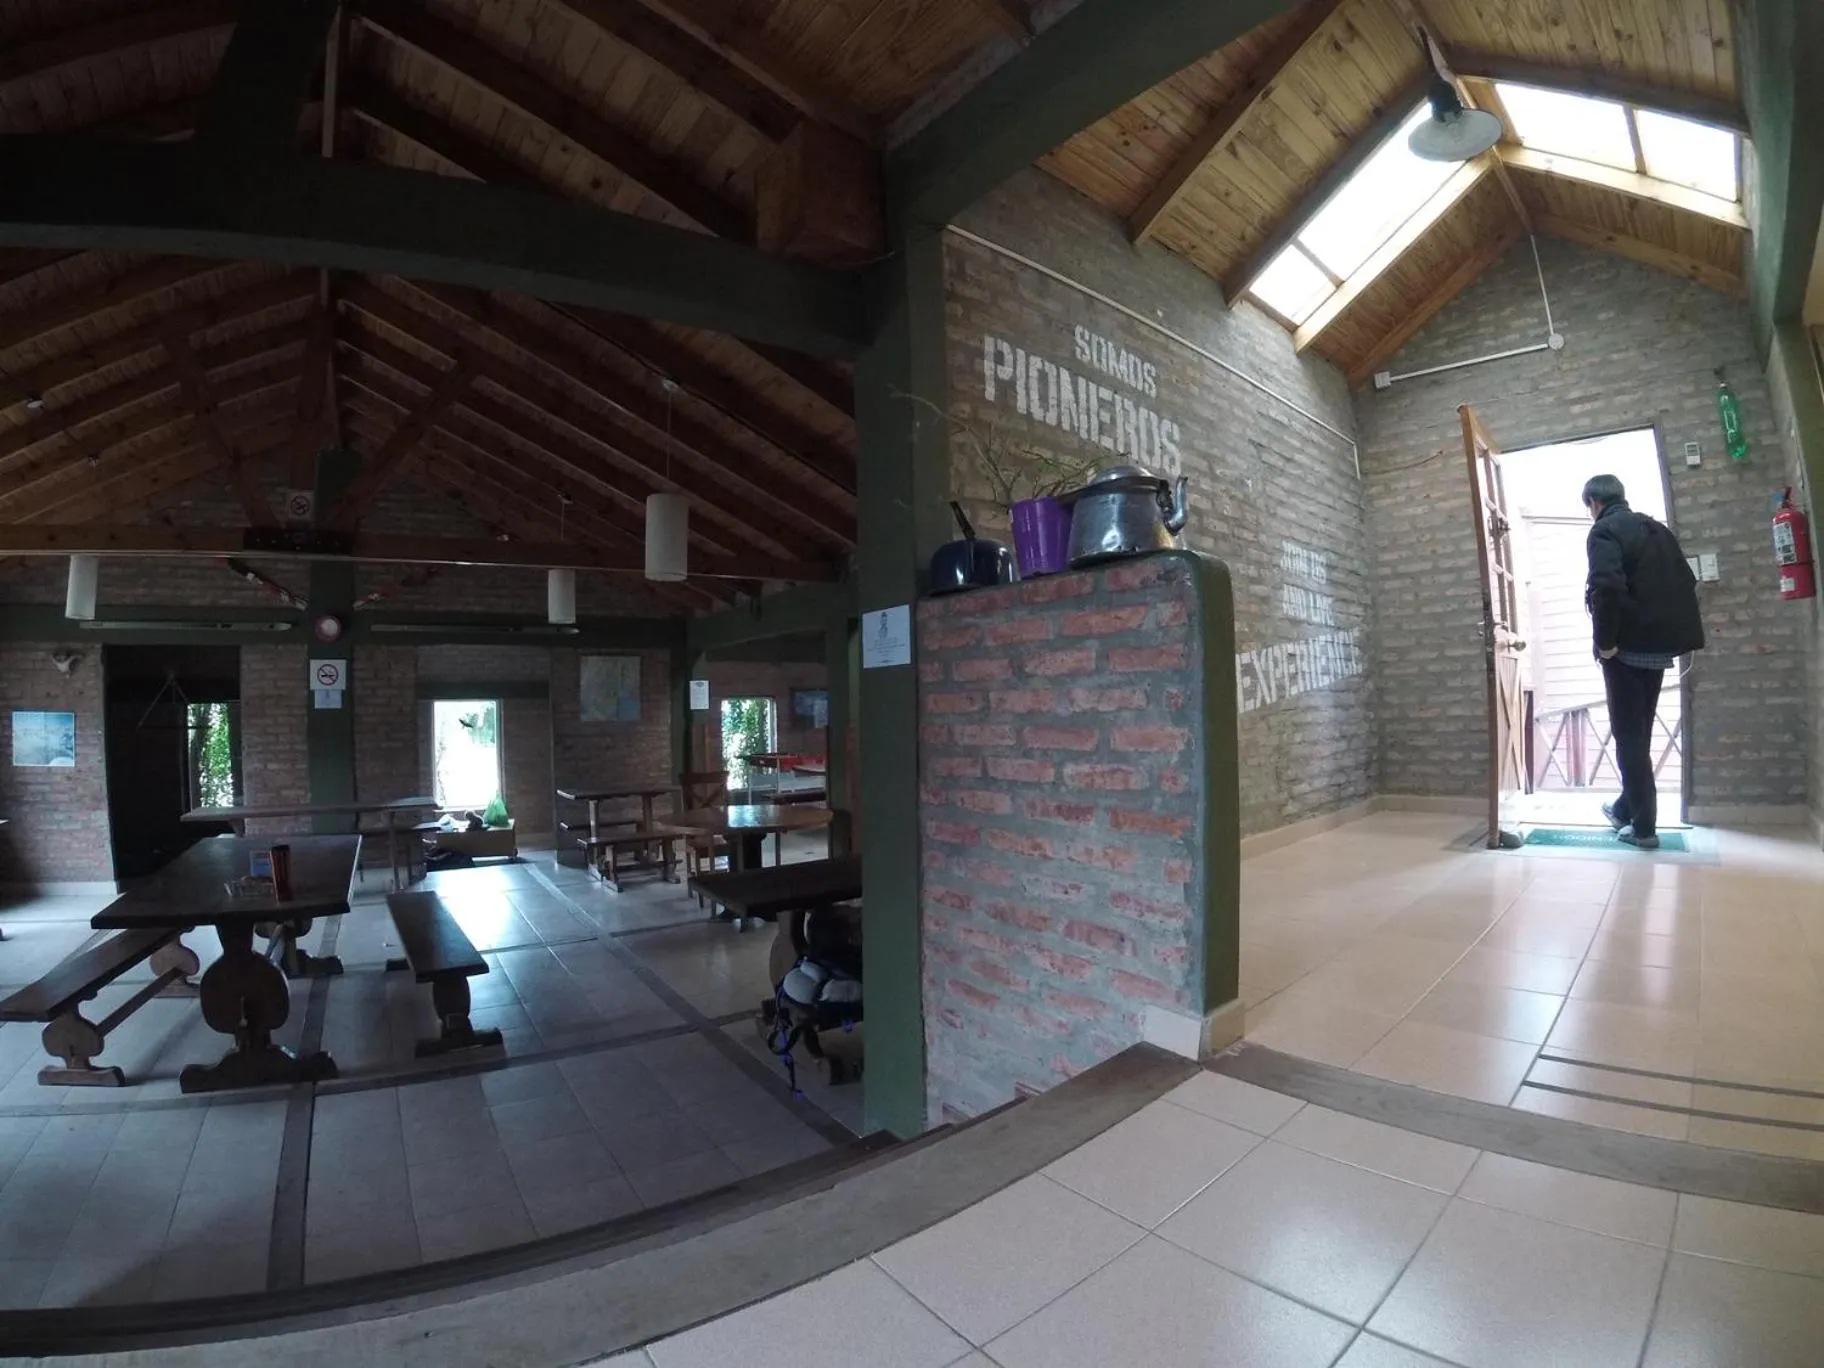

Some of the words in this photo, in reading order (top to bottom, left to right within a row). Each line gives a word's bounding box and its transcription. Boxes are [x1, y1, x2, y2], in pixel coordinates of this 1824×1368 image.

[1074, 324, 1157, 398] SOMOS
[984, 335, 1181, 477] PIONEROS
[1235, 626, 1363, 714] EXPERIENCE
